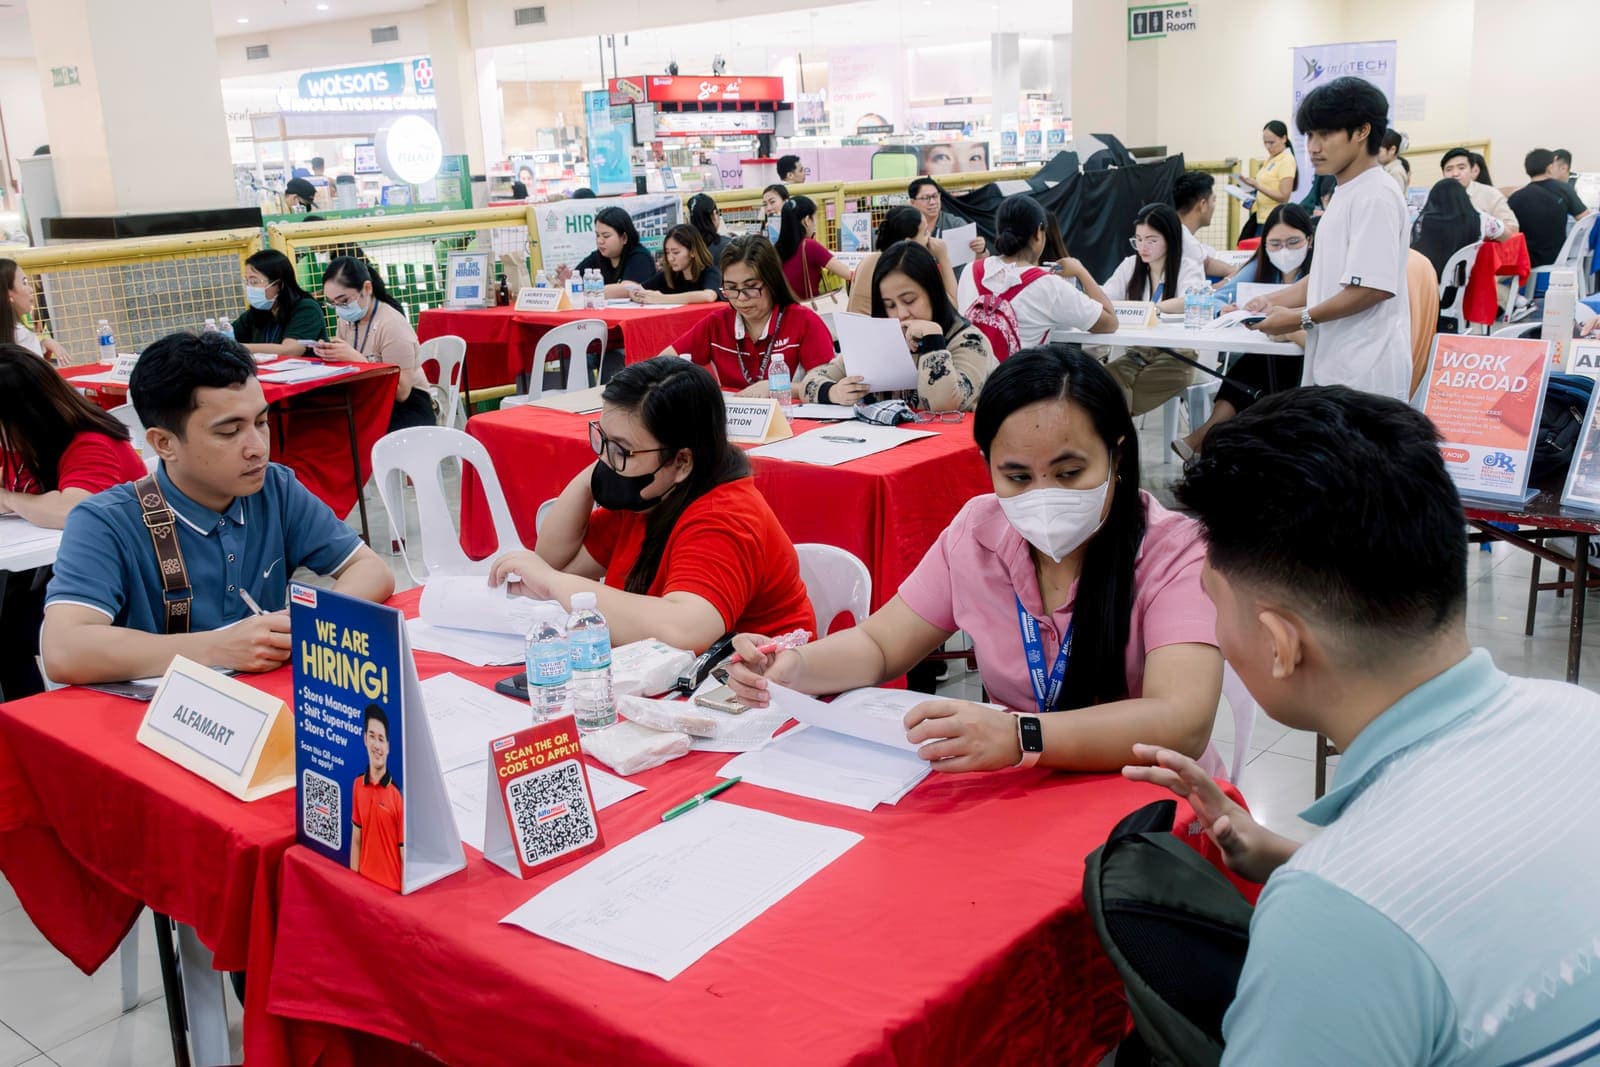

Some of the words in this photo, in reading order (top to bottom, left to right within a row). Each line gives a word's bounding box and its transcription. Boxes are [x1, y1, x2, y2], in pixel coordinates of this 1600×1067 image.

[1166, 8, 1192, 19] Rest
[1166, 22, 1196, 32] Room
[1327, 60, 1387, 73] infoTECH
[307, 71, 389, 97] watsons
[565, 213, 594, 234] HIR
[1115, 308, 1145, 317] EMORE
[1442, 351, 1511, 373] WORK
[1435, 370, 1528, 393] ABROAD
[727, 407, 768, 415] TRUCTION
[315, 618, 337, 646] WE
[341, 627, 370, 656] ARE
[301, 640, 388, 704] HIRING!
[303, 686, 323, 705] Store
[324, 693, 361, 719] Manager
[172, 704, 235, 746] ALFAMART
[304, 702, 321, 720] Shift
[322, 710, 363, 736] Supervisor
[304, 718, 325, 738] Store
[326, 727, 348, 747] Crew
[300, 740, 312, 753] Scan
[313, 746, 322, 756] this
[322, 750, 331, 759] QR
[331, 754, 344, 766] code
[498, 761, 529, 778] CODE
[530, 754, 545, 767] TO
[547, 742, 579, 761] APPLY!
[504, 745, 534, 763] SCAN
[534, 739, 552, 752] THE
[554, 733, 569, 745] QR
[311, 755, 317, 764] to
[318, 758, 334, 771] apply!
[537, 803, 566, 818] Alfamart
